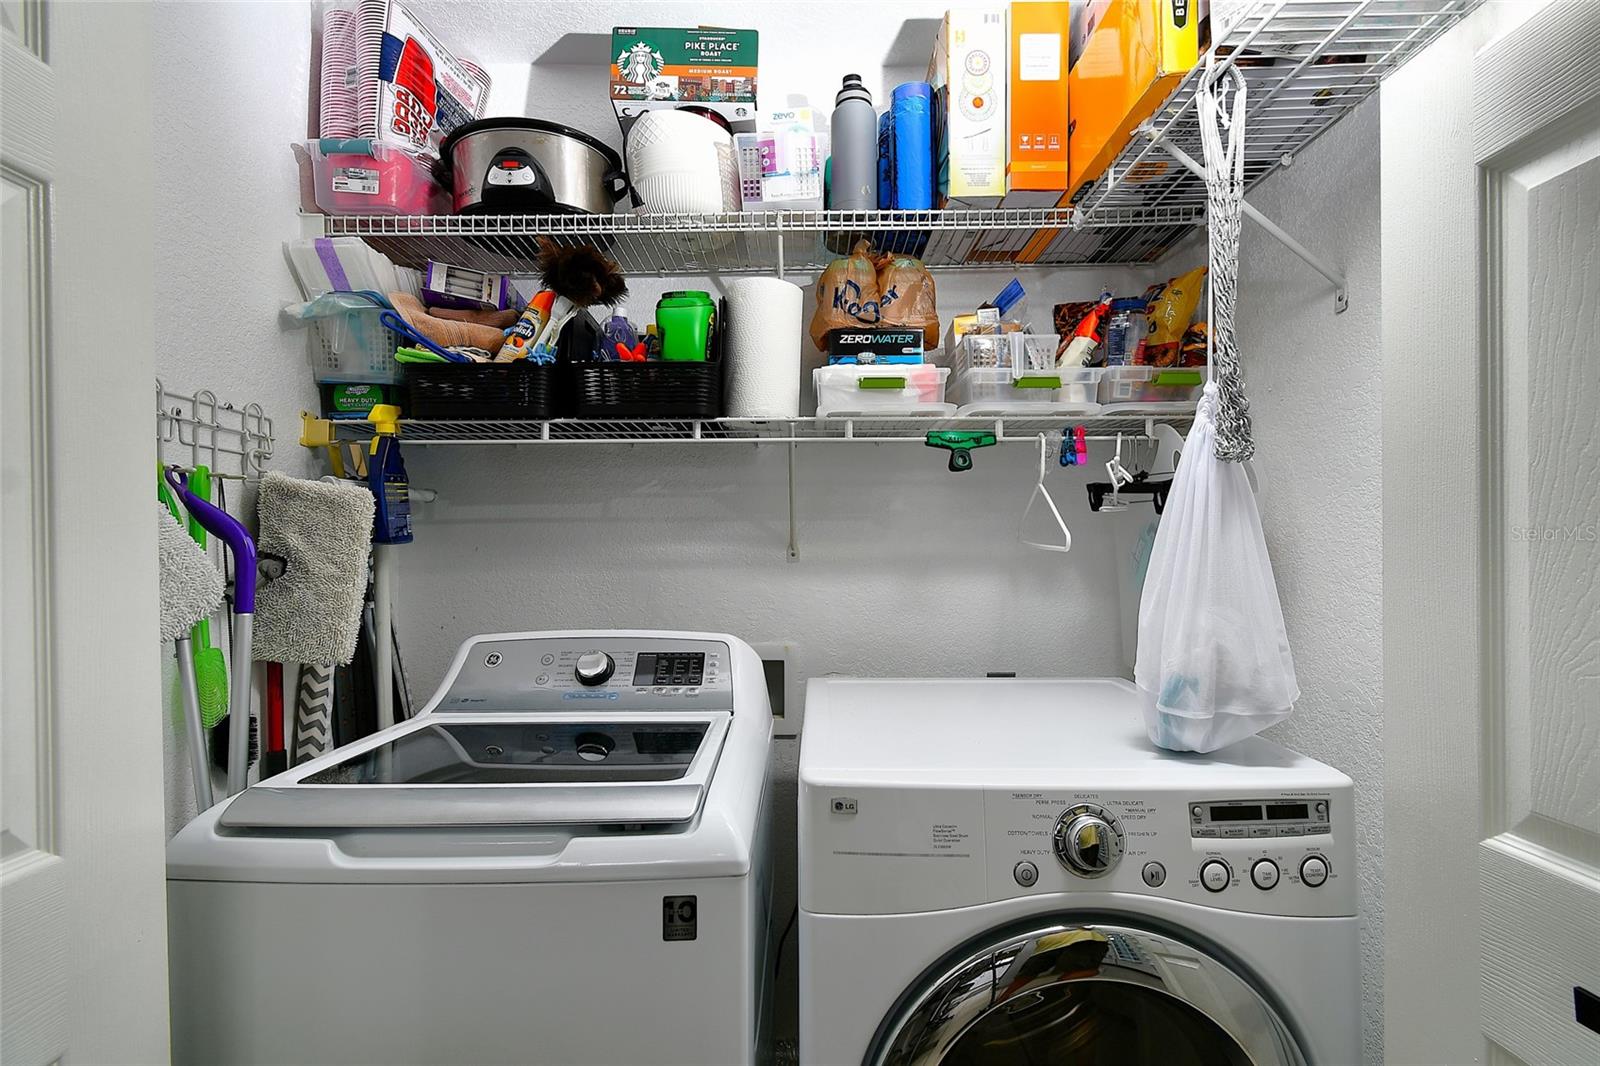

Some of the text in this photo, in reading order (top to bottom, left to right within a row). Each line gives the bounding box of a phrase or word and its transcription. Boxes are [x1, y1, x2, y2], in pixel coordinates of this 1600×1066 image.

[685, 42, 706, 50] PIKE
[613, 85, 627, 95] 72
[772, 112, 795, 120] zevo
[839, 334, 914, 344] ZEROWATER
